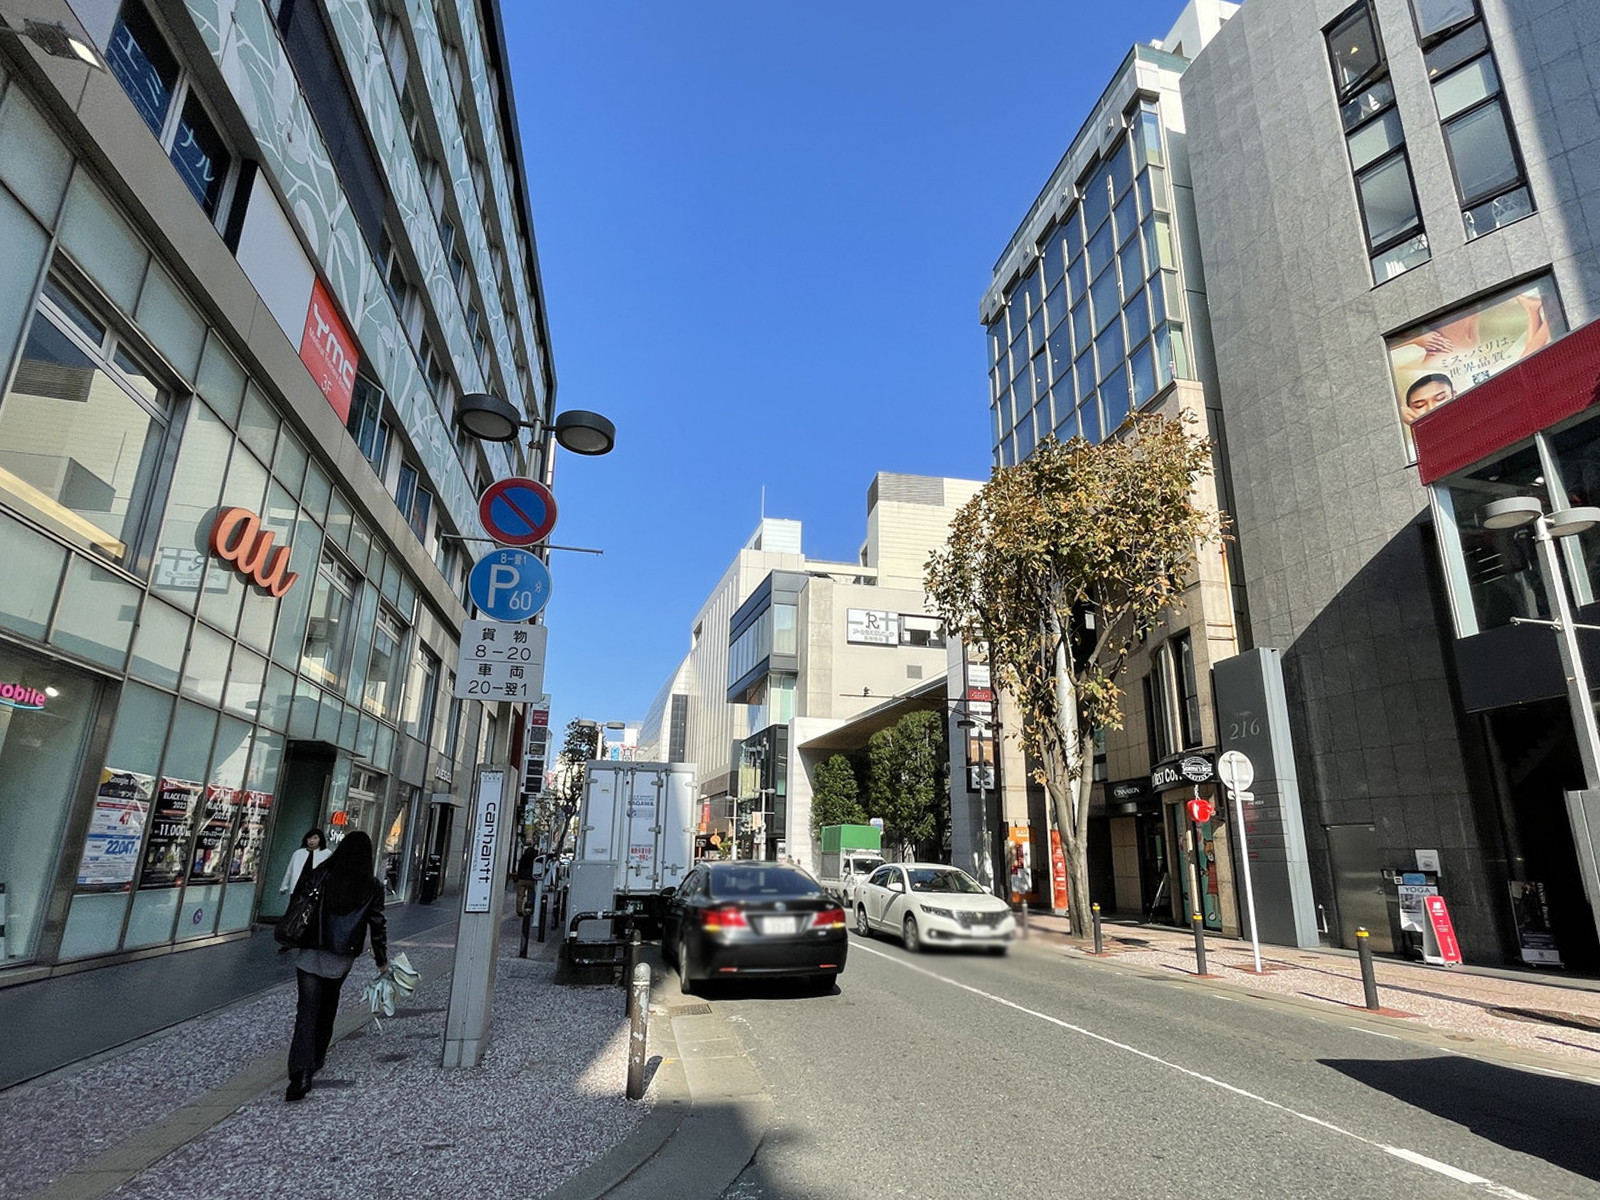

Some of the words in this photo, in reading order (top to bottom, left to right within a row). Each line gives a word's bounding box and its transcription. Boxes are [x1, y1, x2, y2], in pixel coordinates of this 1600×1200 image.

[210, 507, 298, 598] au
[487, 564, 520, 608] P
[509, 591, 532, 610] 60
[481, 627, 528, 644] 貨物
[475, 644, 532, 661] 8-20
[478, 663, 524, 680] 車両
[0, 683, 46, 707] obile
[468, 680, 527, 697] 20-翌1
[1229, 717, 1260, 741] 216
[478, 802, 496, 884] carhartt
